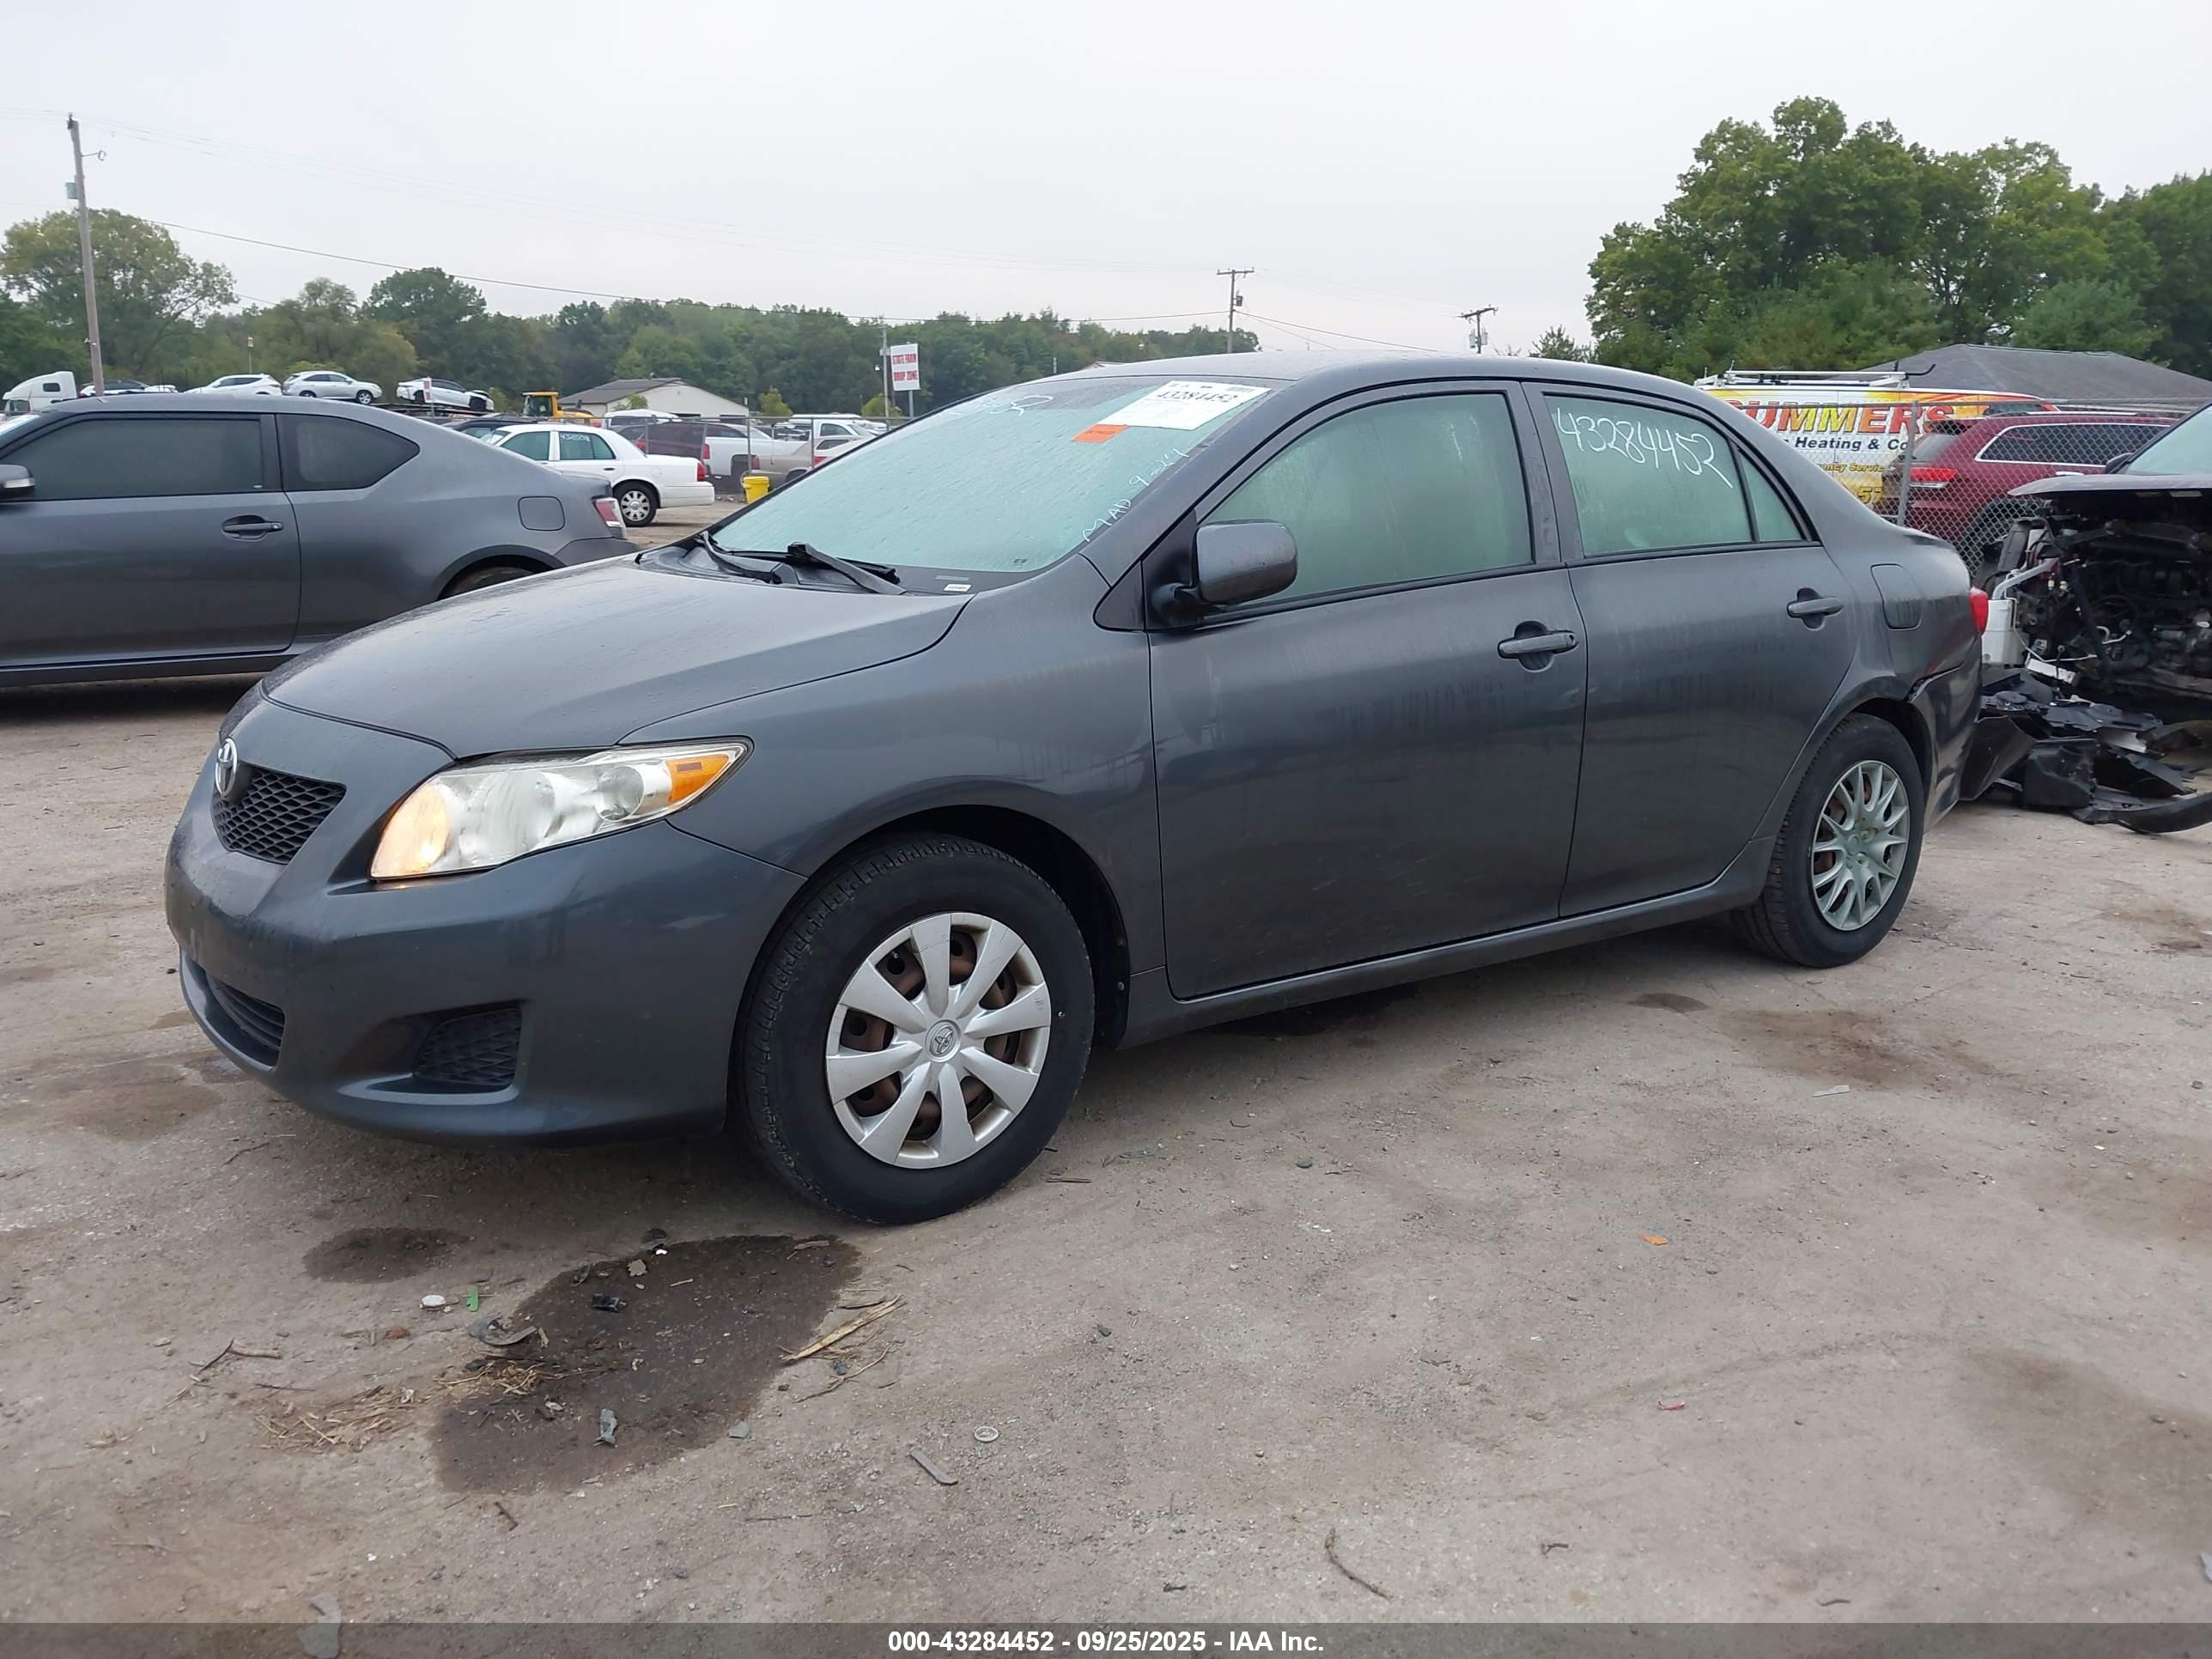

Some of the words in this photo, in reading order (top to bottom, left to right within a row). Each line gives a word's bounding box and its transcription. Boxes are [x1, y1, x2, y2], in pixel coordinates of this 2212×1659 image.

[907, 370, 919, 380] ZONE
[1724, 399, 1954, 434] UMMERS
[1557, 407, 1733, 489] 43284452
[1795, 437, 1862, 452] Heating
[1868, 438, 1881, 450] &
[1082, 499, 1131, 542] MAD
